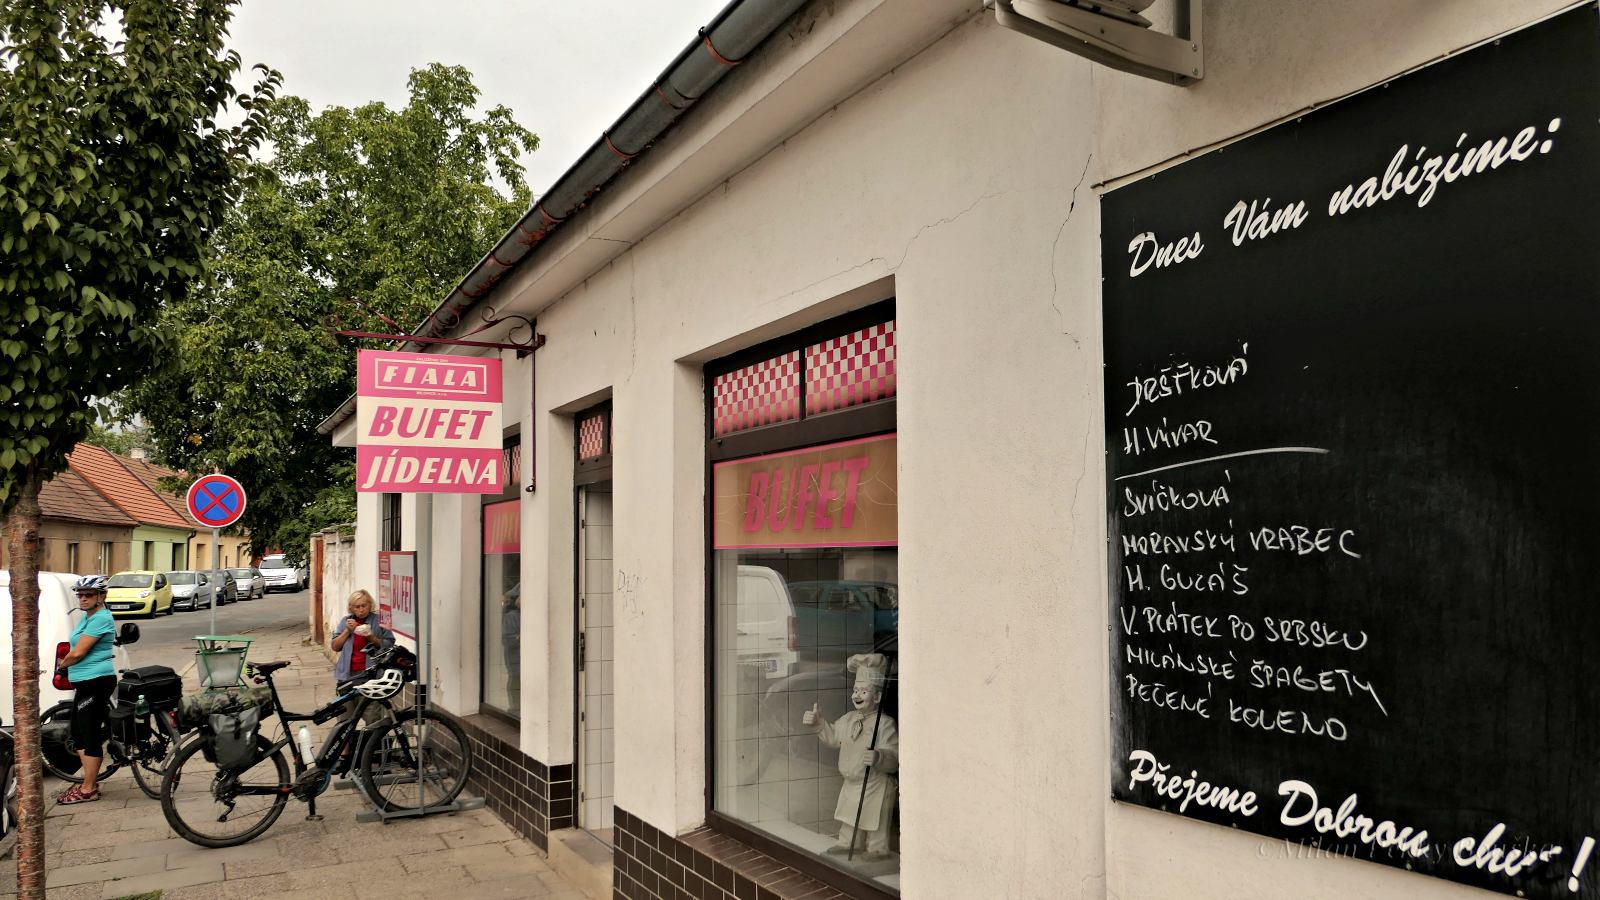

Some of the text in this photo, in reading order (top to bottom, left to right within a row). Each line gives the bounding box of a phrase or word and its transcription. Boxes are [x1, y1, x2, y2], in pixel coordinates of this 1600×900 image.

[1128, 117, 1561, 278] Dnes Vám nabízíme:
[383, 365, 477, 387] FIALA
[368, 405, 493, 441] BUFET
[361, 449, 497, 489] JÍDELNA
[743, 456, 869, 533] BUFET
[1250, 526, 1361, 559] VRABEC
[392, 574, 413, 614] BUFET
[1228, 615, 1255, 642] PO
[1264, 616, 1368, 650] SRBSKU
[1230, 698, 1347, 740] KOLENO
[1129, 750, 1258, 815] Přejeme
[1278, 780, 1429, 858] Dobrou
